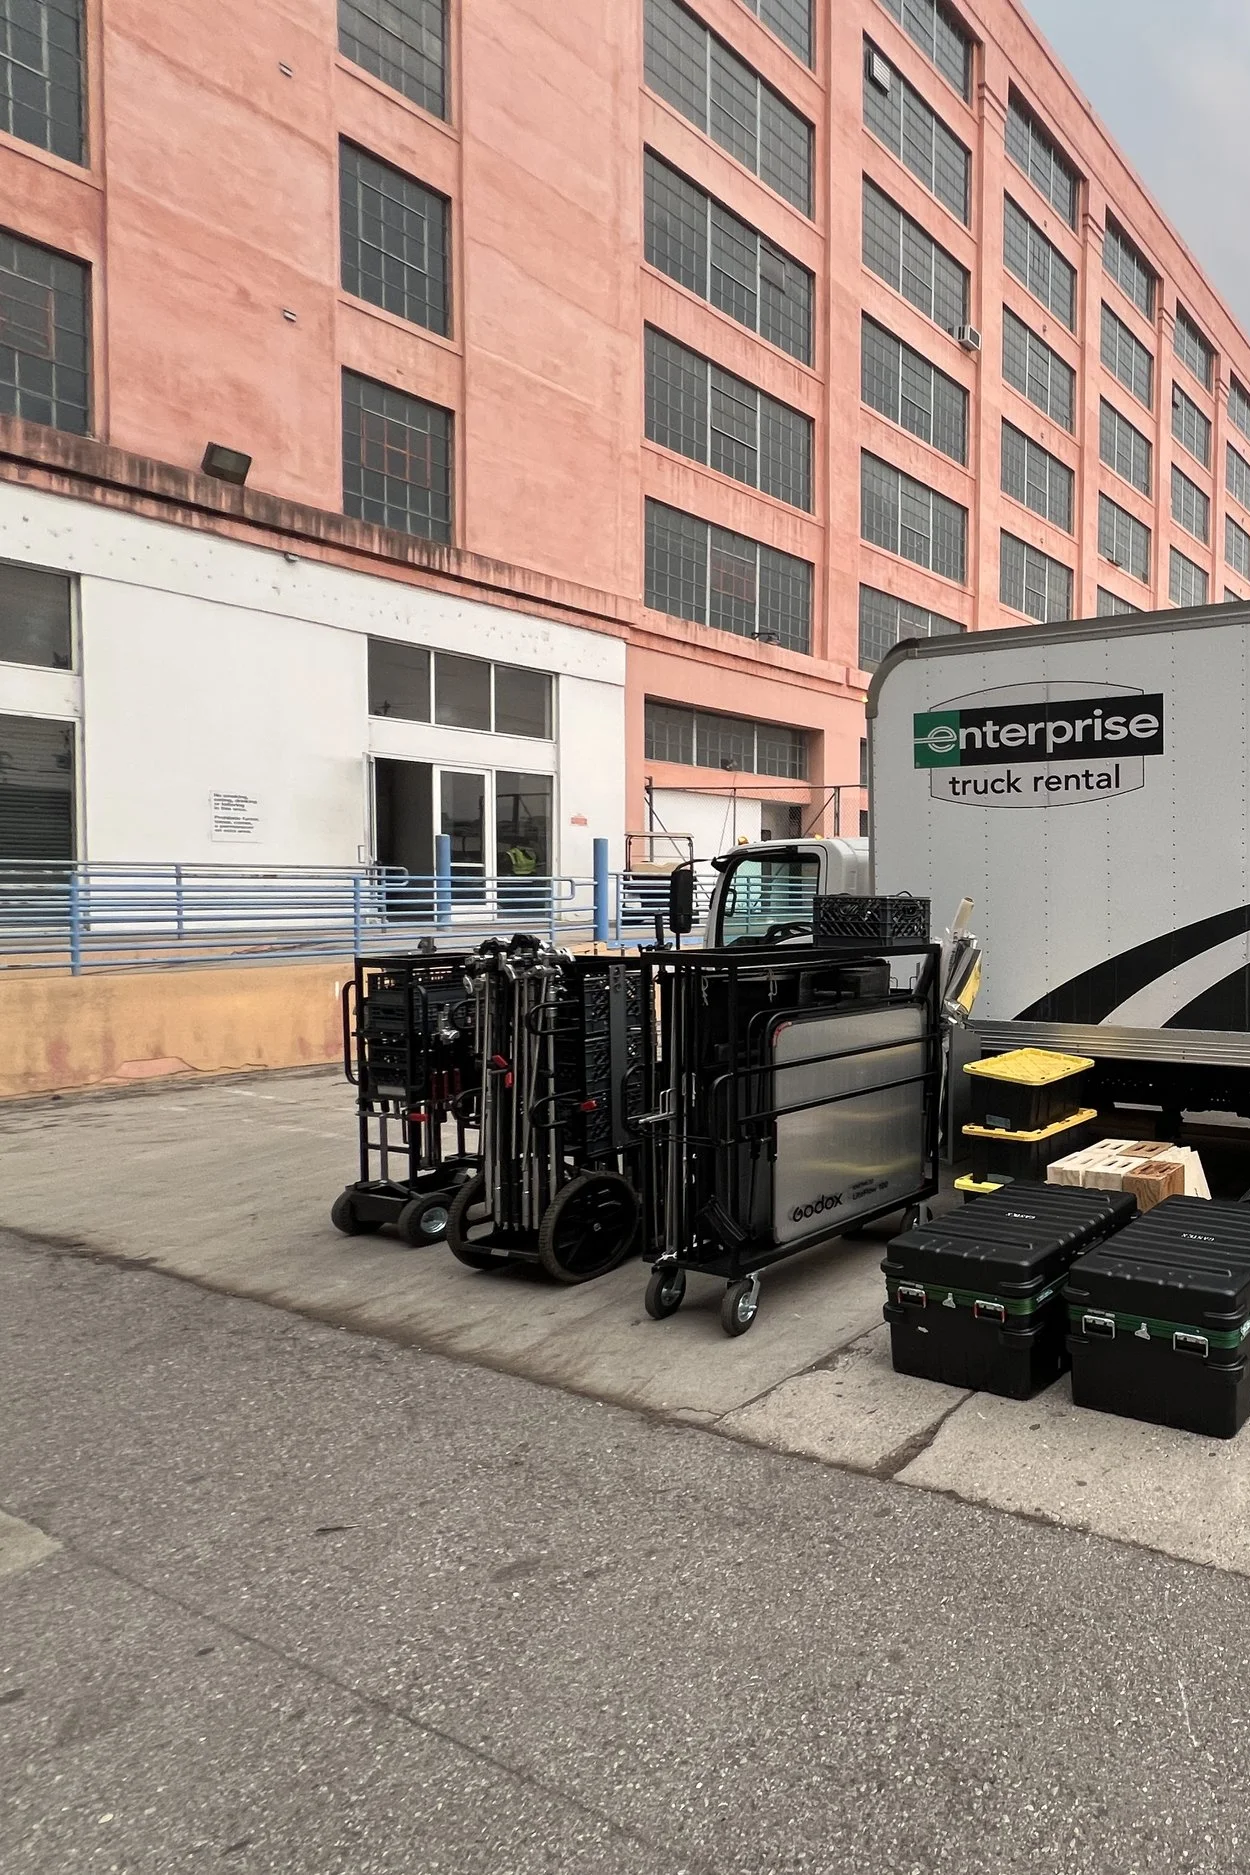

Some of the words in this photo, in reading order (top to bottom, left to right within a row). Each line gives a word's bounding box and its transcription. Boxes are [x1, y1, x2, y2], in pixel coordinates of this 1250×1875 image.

[914, 708, 1160, 754] enterprise
[948, 769, 1023, 796] truck
[1033, 763, 1121, 792] rental
[792, 1193, 843, 1222] Godox
